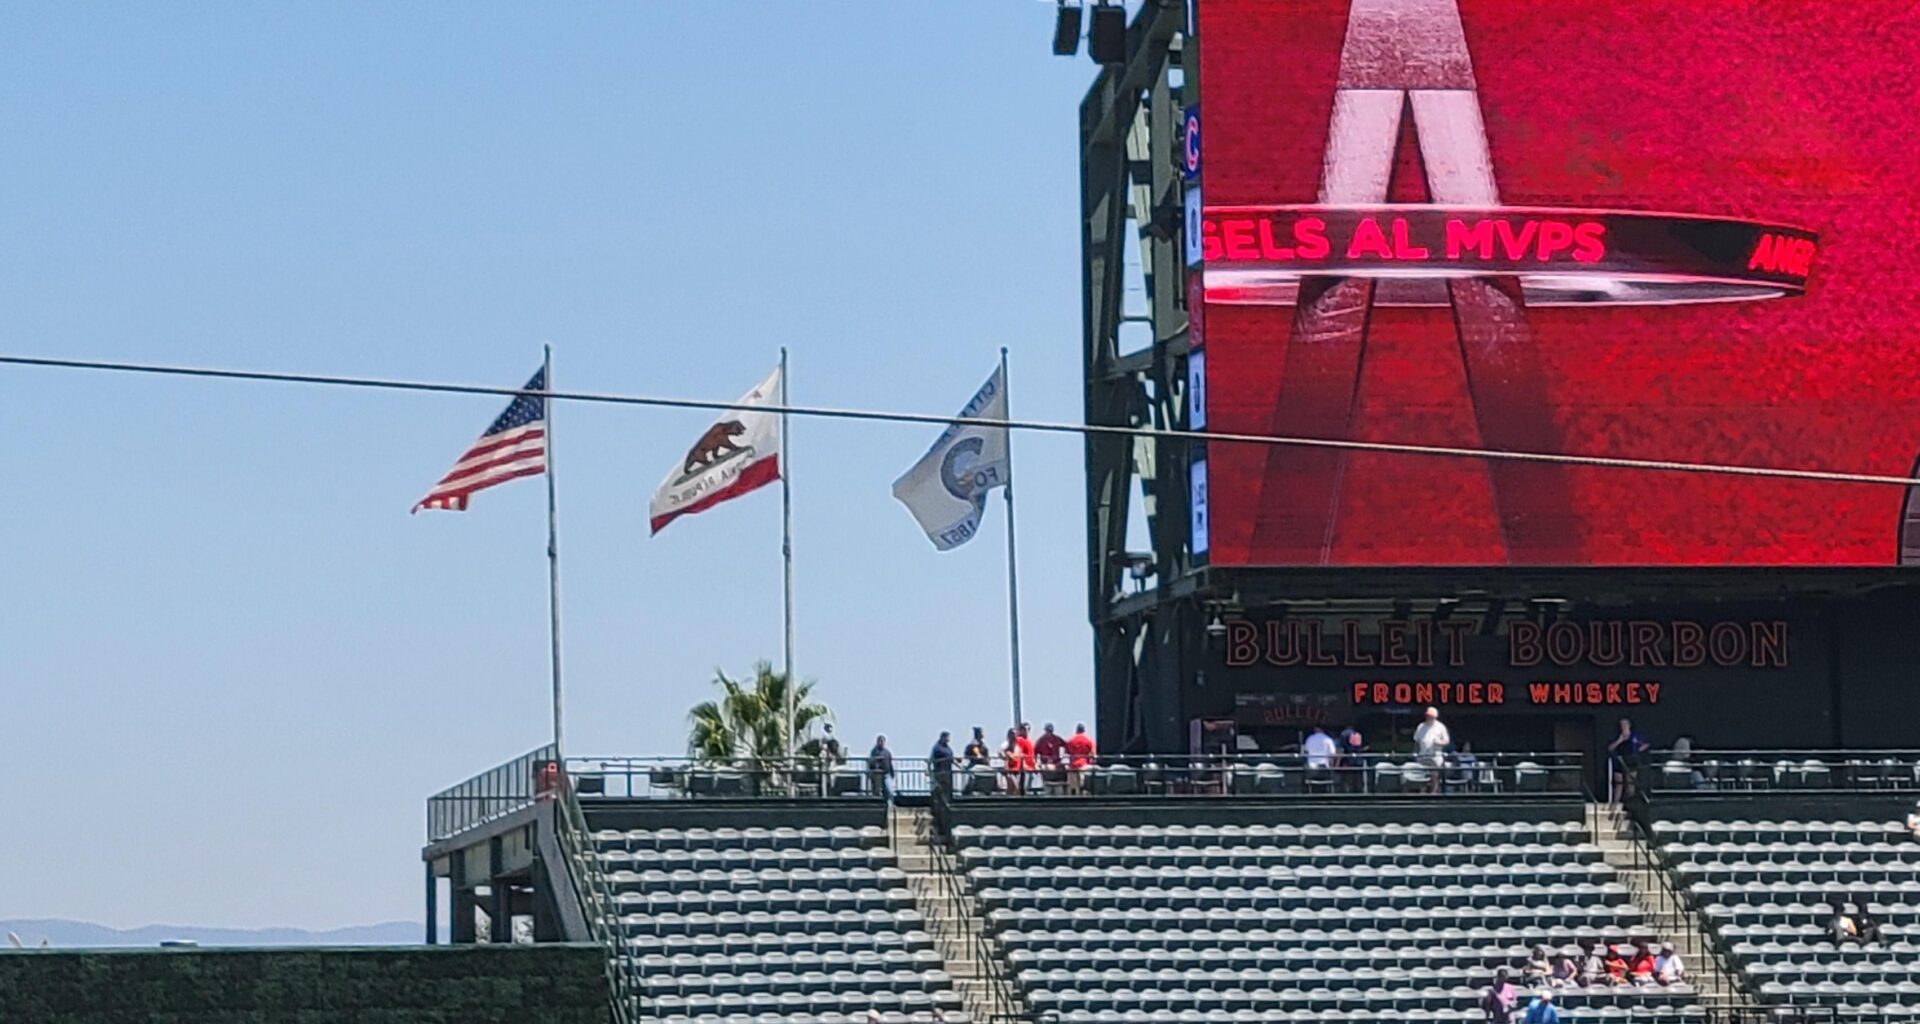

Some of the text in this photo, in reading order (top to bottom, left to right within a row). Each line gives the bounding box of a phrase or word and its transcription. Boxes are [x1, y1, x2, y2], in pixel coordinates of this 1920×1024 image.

[1346, 218, 1429, 260] AL
[1446, 219, 1606, 262] MVPS
[1225, 618, 1788, 667] BULLEIT BOURBON
[1354, 682, 1504, 704] FRONTIER
[1529, 682, 1661, 704] WHISKEY
